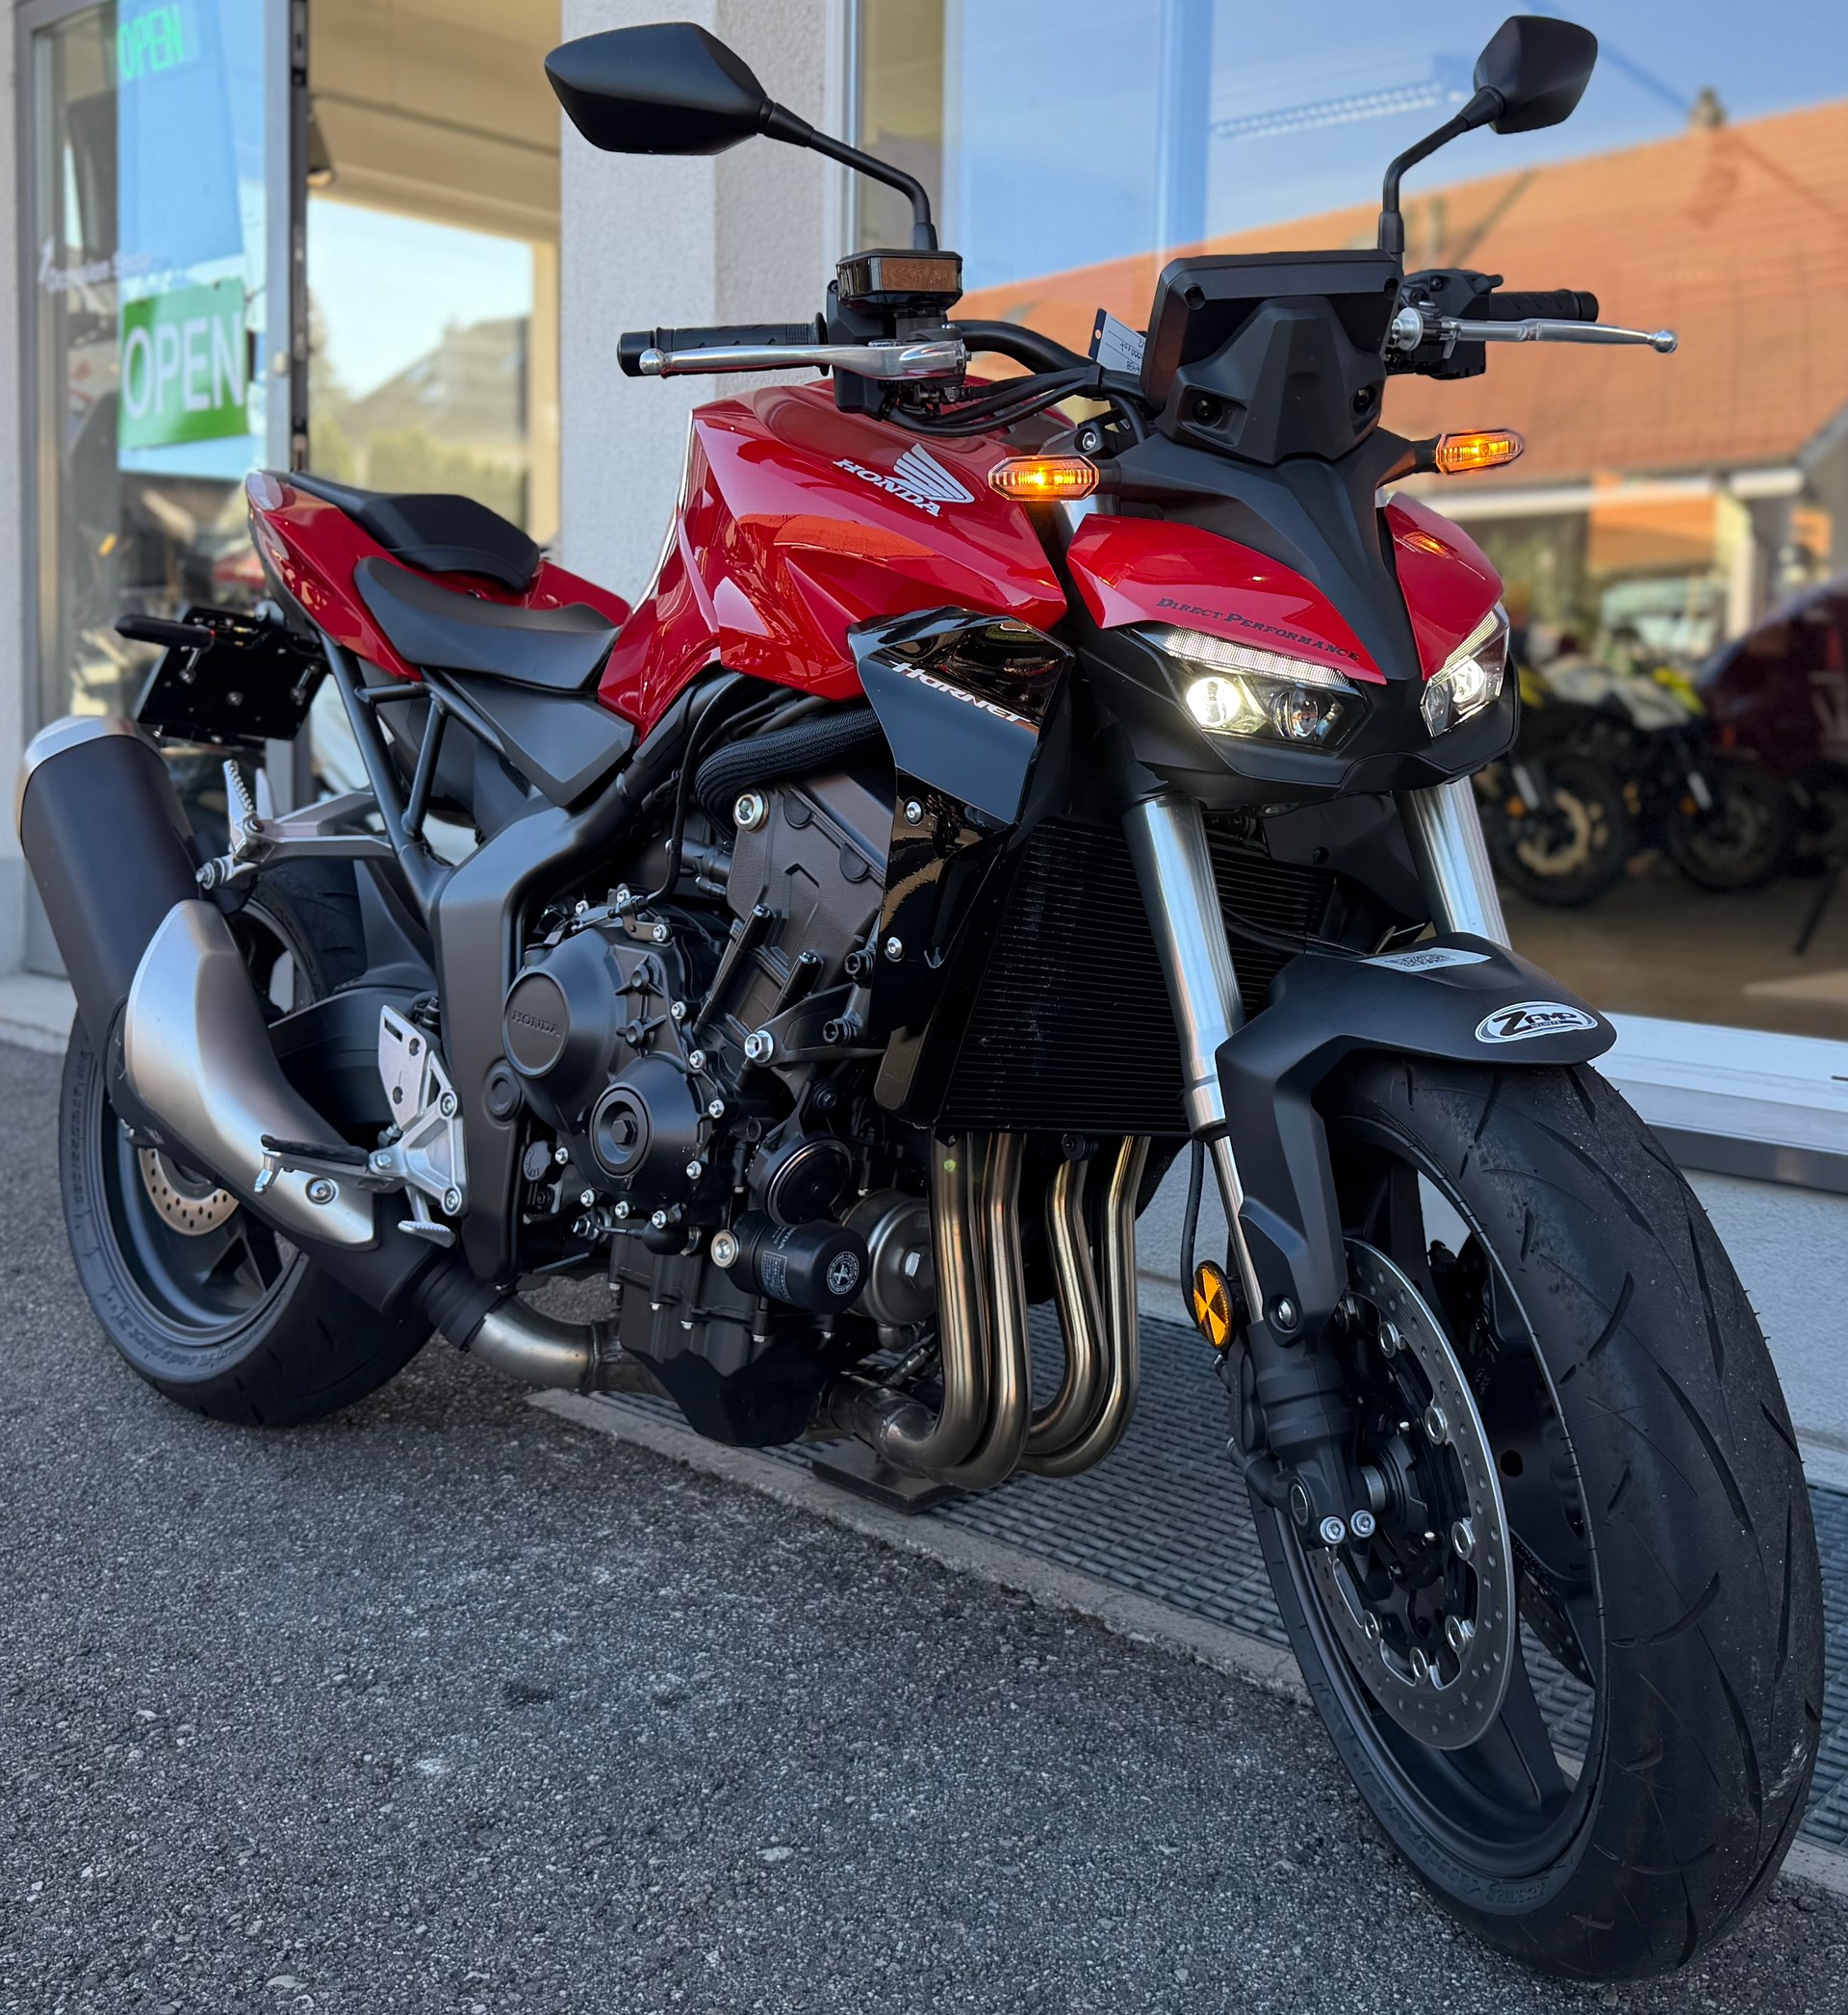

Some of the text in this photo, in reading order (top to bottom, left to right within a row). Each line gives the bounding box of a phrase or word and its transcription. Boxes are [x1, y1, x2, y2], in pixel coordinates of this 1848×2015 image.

[117, 3, 183, 81] OPEN
[122, 313, 244, 419] OPEN
[833, 458, 941, 517] HONDA
[1156, 598, 1362, 661] DIRECT PERFORMANCE
[888, 659, 1031, 723] HORNET
[511, 1010, 561, 1037] HONDA
